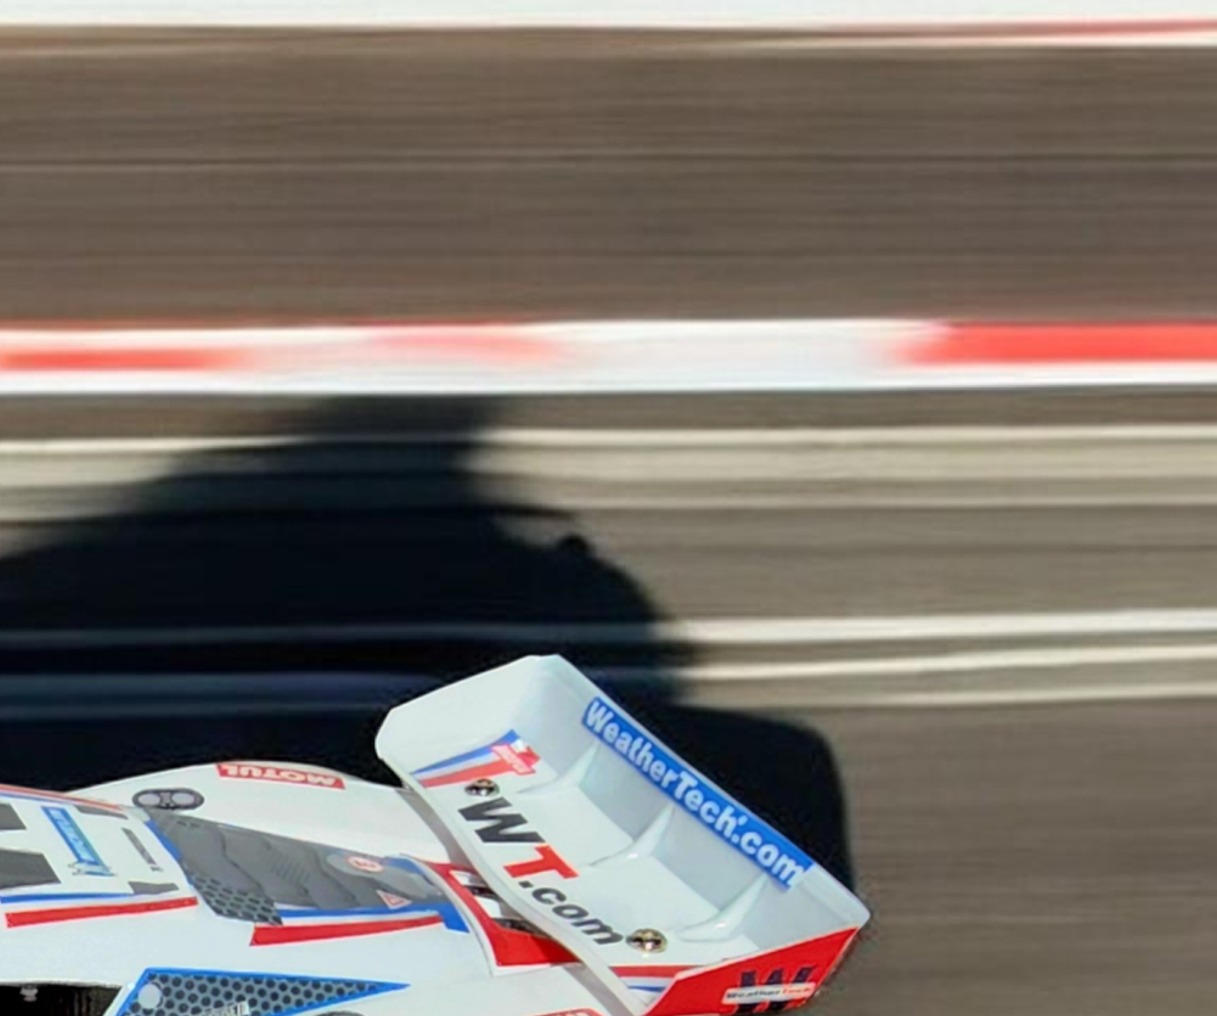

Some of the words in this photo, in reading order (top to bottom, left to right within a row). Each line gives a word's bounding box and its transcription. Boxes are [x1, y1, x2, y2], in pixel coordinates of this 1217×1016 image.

[222, 764, 338, 786] MOTUL
[587, 700, 806, 888] WeatherTech.com
[458, 796, 624, 945] WT.com
